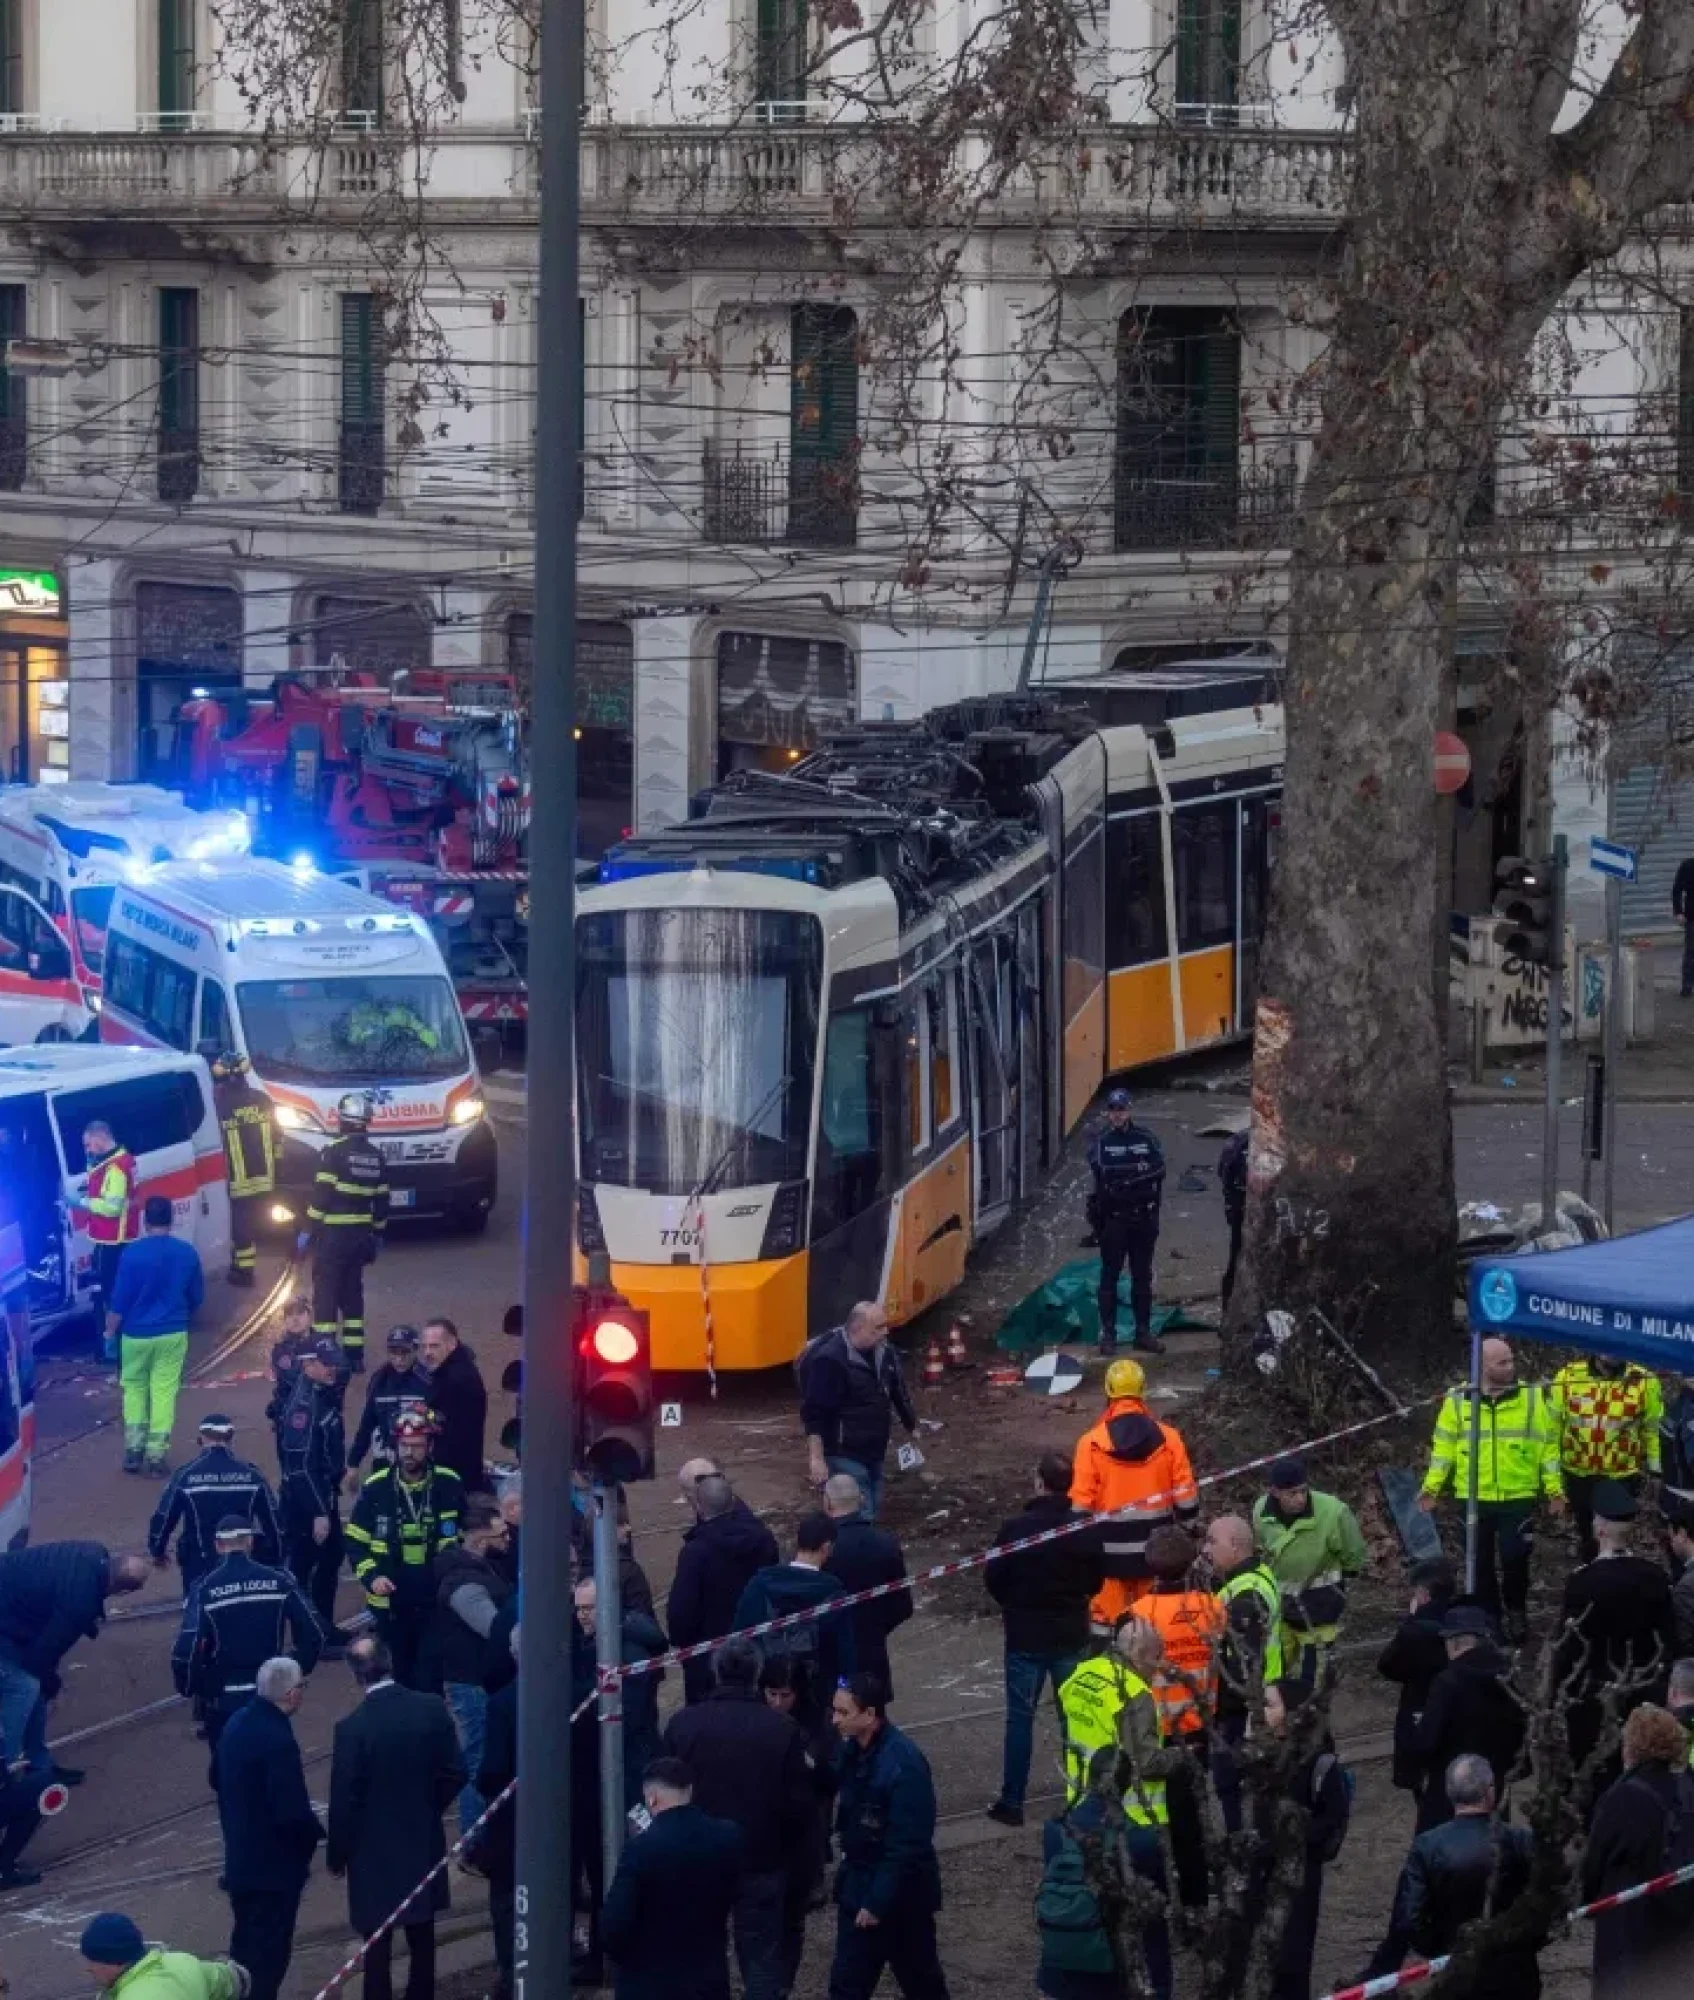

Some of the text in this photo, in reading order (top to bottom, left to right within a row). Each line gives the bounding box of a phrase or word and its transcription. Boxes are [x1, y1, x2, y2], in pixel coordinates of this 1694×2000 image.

[1529, 1294, 1603, 1326] COMUNE
[1613, 1312, 1632, 1330] DI
[663, 1406, 679, 1422] A
[243, 1579, 278, 1592] LOCALE
